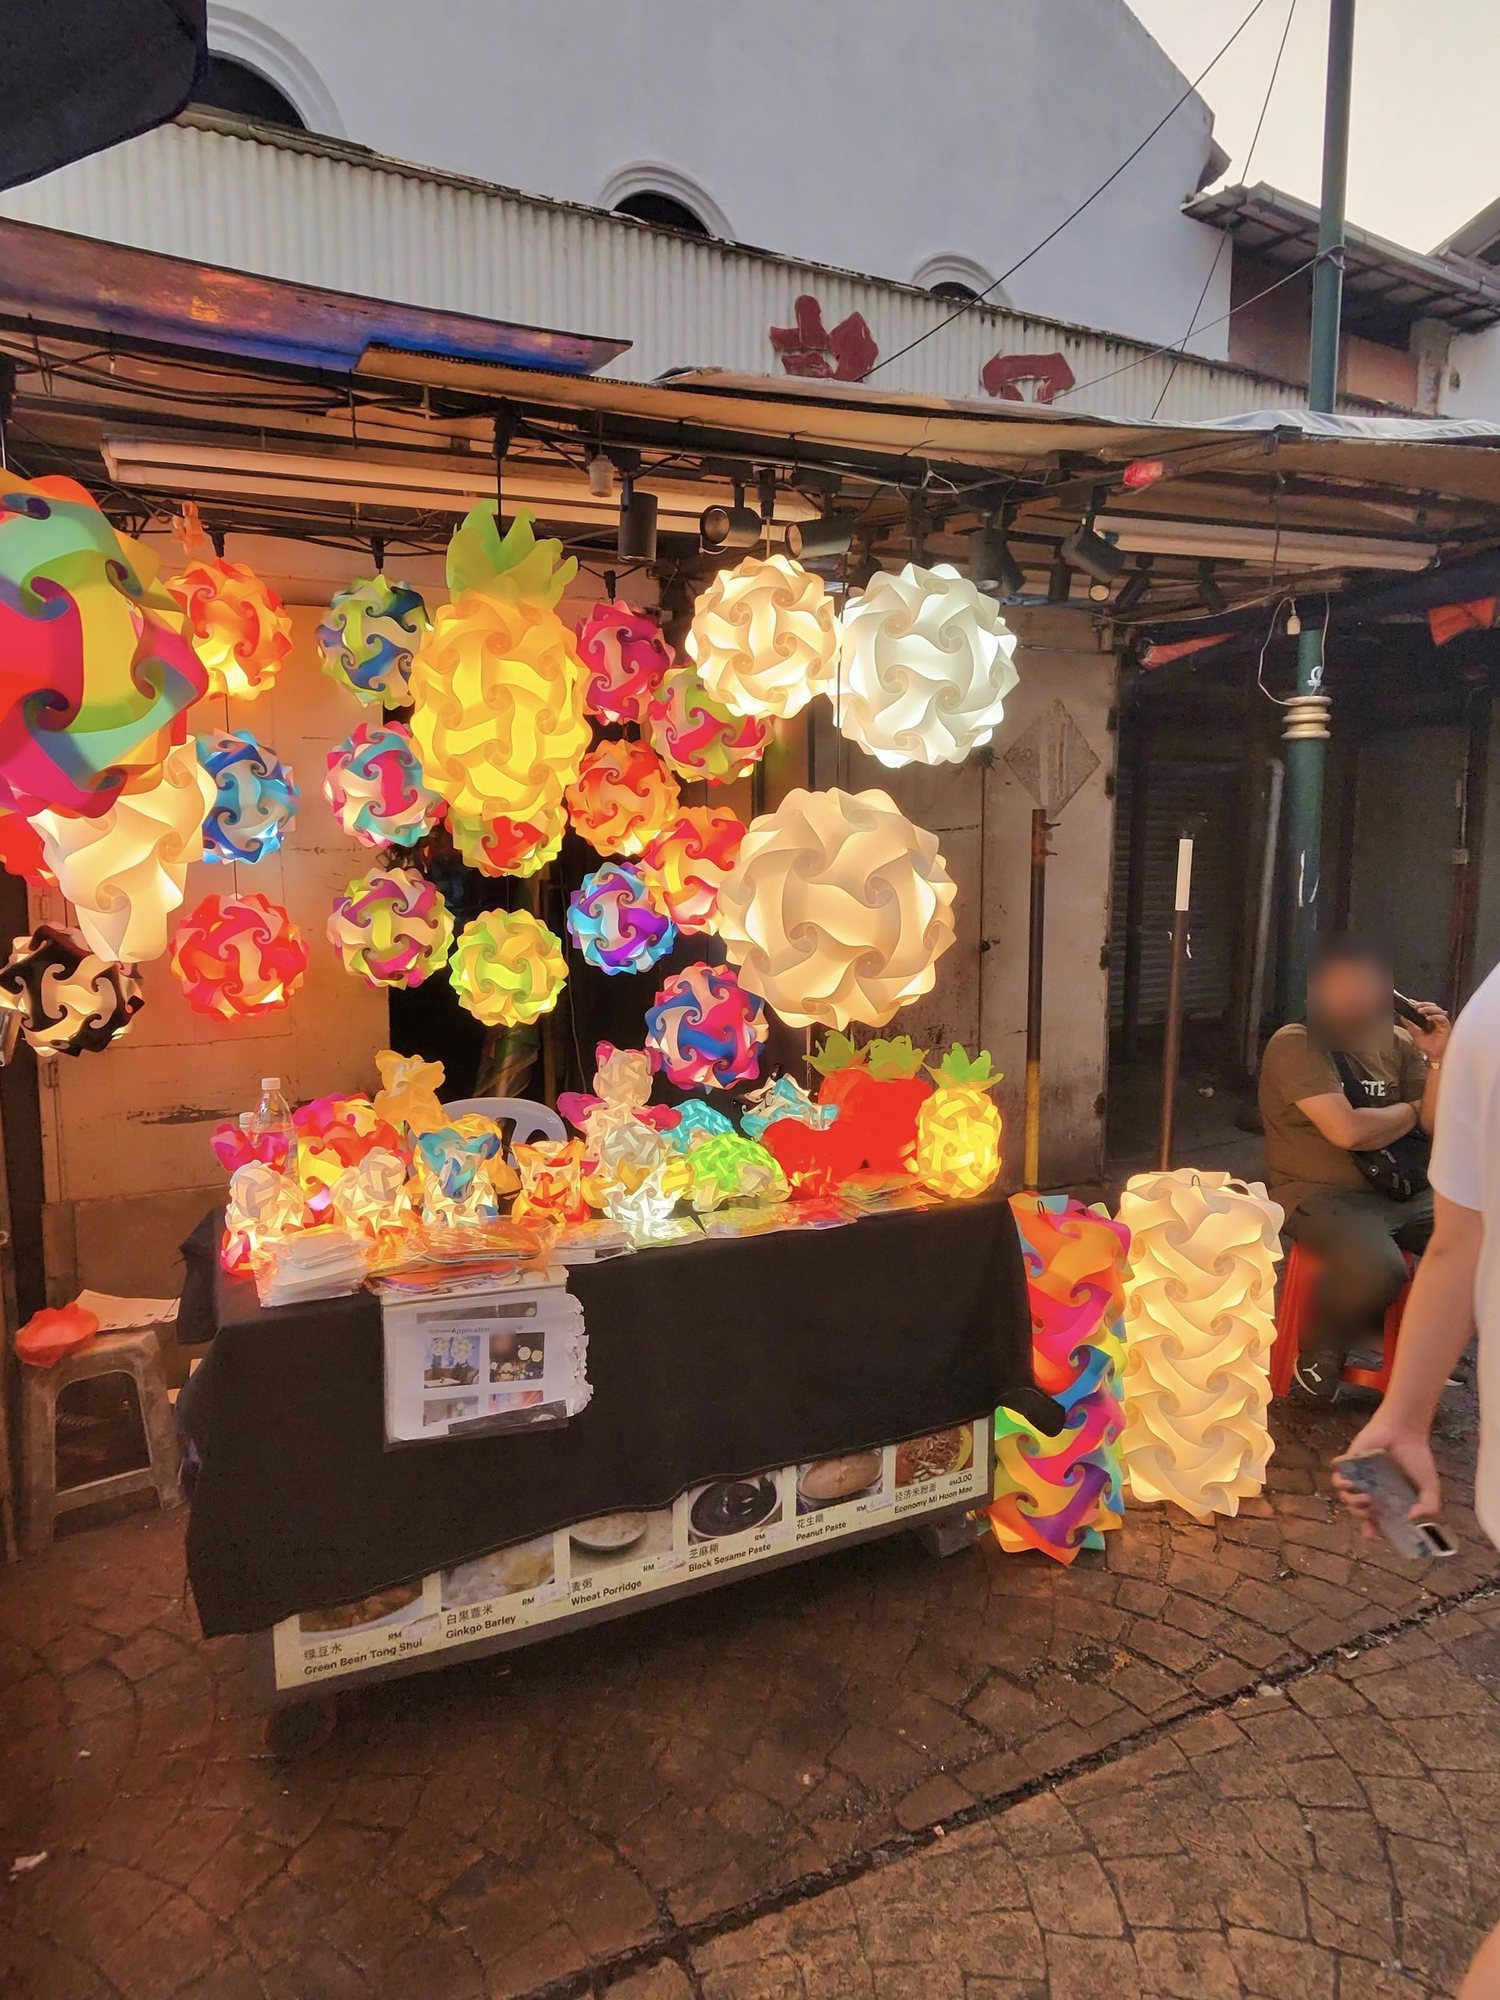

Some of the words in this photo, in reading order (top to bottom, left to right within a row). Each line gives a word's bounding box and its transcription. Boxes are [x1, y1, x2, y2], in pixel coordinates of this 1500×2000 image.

[856, 1504, 867, 1513] RM
[894, 1499, 927, 1514] Economy
[928, 1495, 937, 1503] Mi
[939, 1490, 957, 1502] Hoon
[958, 1485, 973, 1496] Mee
[796, 1513, 824, 1530] 花生糊
[796, 1528, 823, 1542] Peanut
[825, 1521, 847, 1533] Paste
[688, 1558, 712, 1573] Black
[714, 1551, 747, 1565] Sesame
[748, 1543, 771, 1556] Paste
[689, 1542, 719, 1560] 芝麻糊
[642, 1563, 655, 1573] RM
[521, 1597, 535, 1607] RM
[571, 1591, 601, 1606] Wheat
[602, 1580, 642, 1598] Porridge
[445, 1624, 483, 1640] Ginkgo
[484, 1615, 517, 1627] Barley
[303, 1642, 343, 1661] 绿豆水
[304, 1661, 338, 1676] Green
[340, 1653, 367, 1667] Bean
[369, 1646, 397, 1660] Tong
